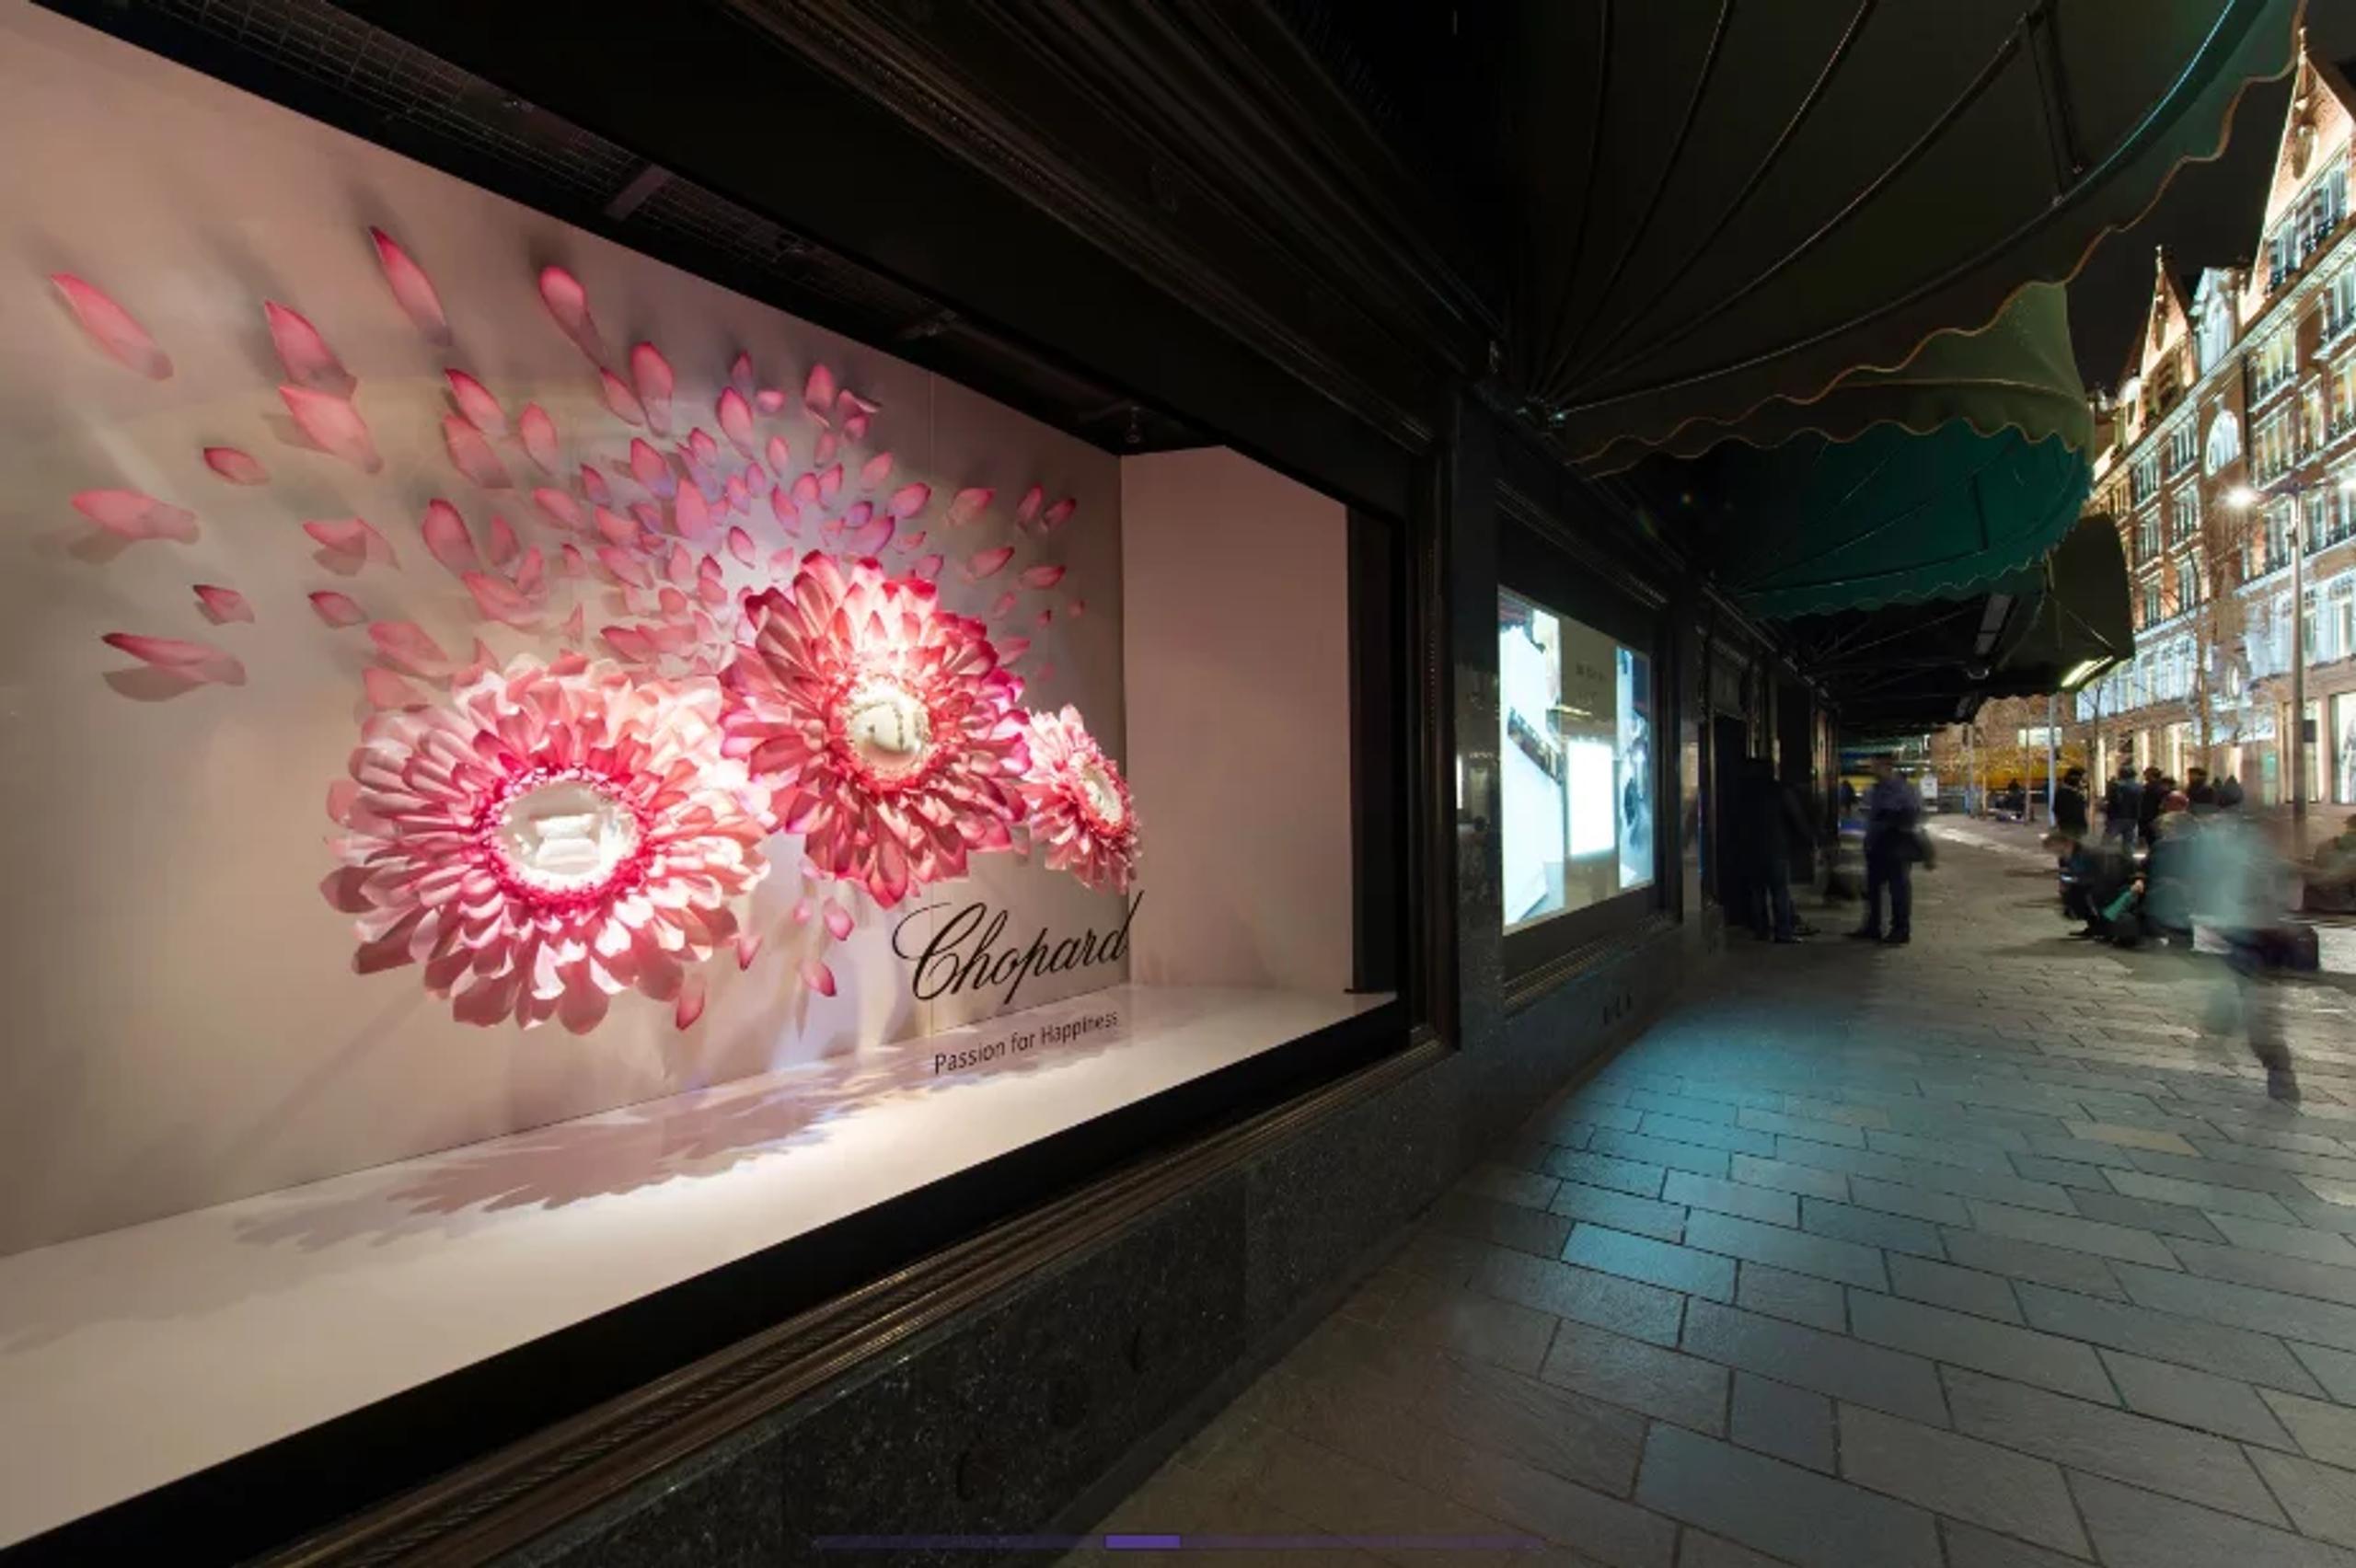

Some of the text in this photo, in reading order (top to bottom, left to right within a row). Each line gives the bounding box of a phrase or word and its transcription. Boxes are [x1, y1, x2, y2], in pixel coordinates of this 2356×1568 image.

[892, 890, 1144, 1004] Chopard
[934, 1010, 1118, 1074] Passion for Happiness
